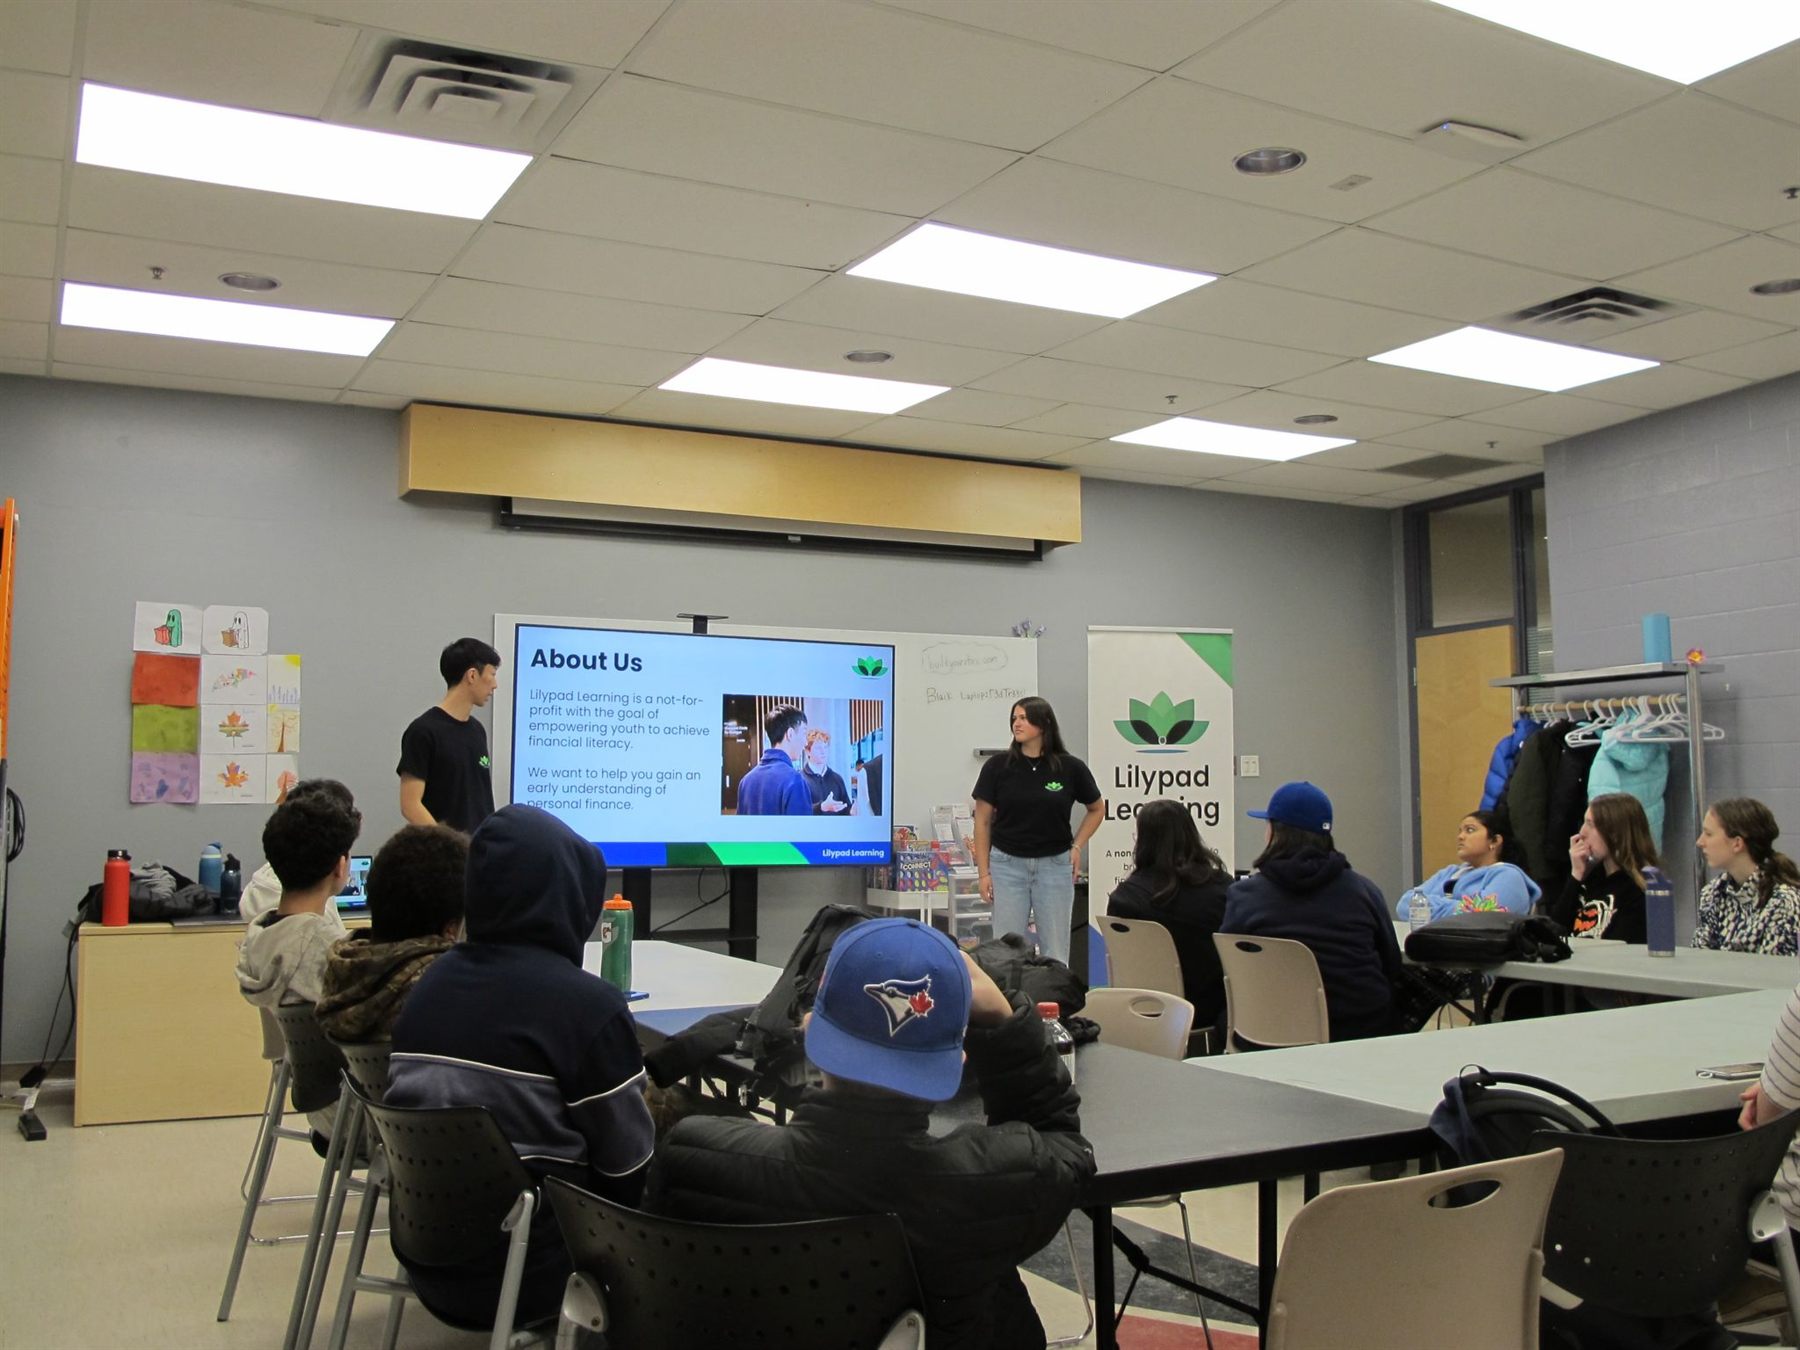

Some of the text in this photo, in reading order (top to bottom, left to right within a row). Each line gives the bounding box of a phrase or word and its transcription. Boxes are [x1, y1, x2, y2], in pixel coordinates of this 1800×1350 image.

[530, 648, 643, 672] About Us
[530, 688, 704, 707] Lilypad Learning is a not-for-
[529, 704, 660, 721] profit with the goal of
[529, 721, 608, 736] empowering
[611, 723, 646, 738] youth
[648, 724, 660, 736] to
[663, 724, 711, 737] achieve
[528, 735, 634, 752] financial literacy.
[527, 767, 701, 783] We want to help you gain an
[1115, 764, 1210, 795] Lilypad
[527, 783, 667, 797] early understanding of
[527, 798, 635, 811] personal finance.
[822, 848, 885, 859] Lilypad Learning
[1106, 850, 1112, 858] A
[902, 861, 931, 871] CONNECT
